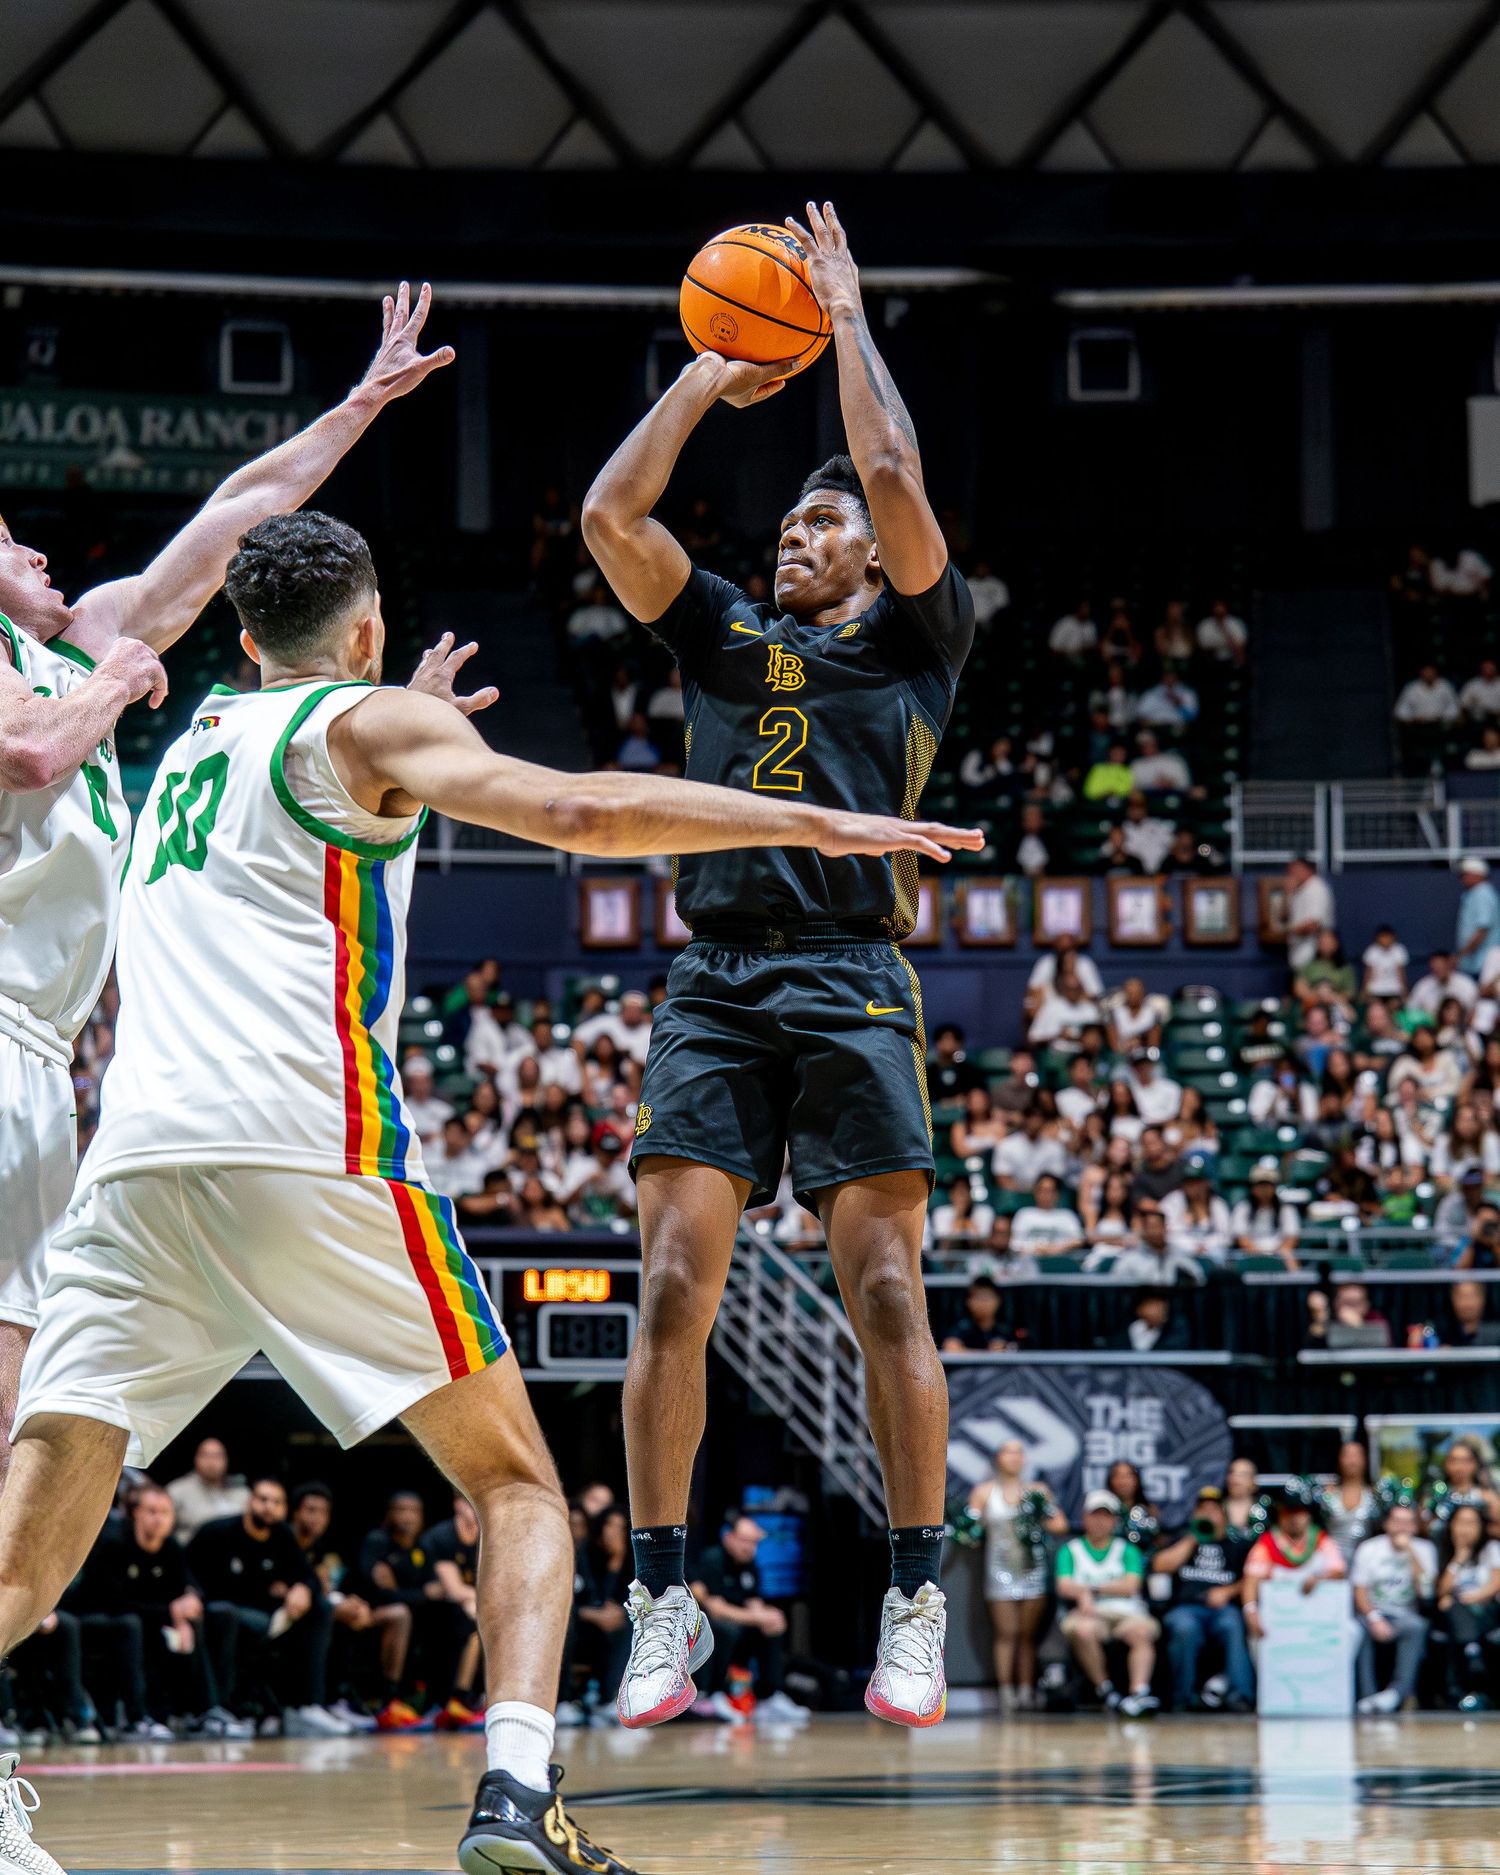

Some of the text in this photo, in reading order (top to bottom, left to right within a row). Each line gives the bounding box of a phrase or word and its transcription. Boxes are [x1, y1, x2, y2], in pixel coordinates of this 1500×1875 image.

[752, 706, 808, 792] 2
[145, 750, 230, 885] 10
[1084, 1396, 1163, 1430] THE
[1085, 1430, 1156, 1465] BIG
[1081, 1463, 1189, 1502] WST
